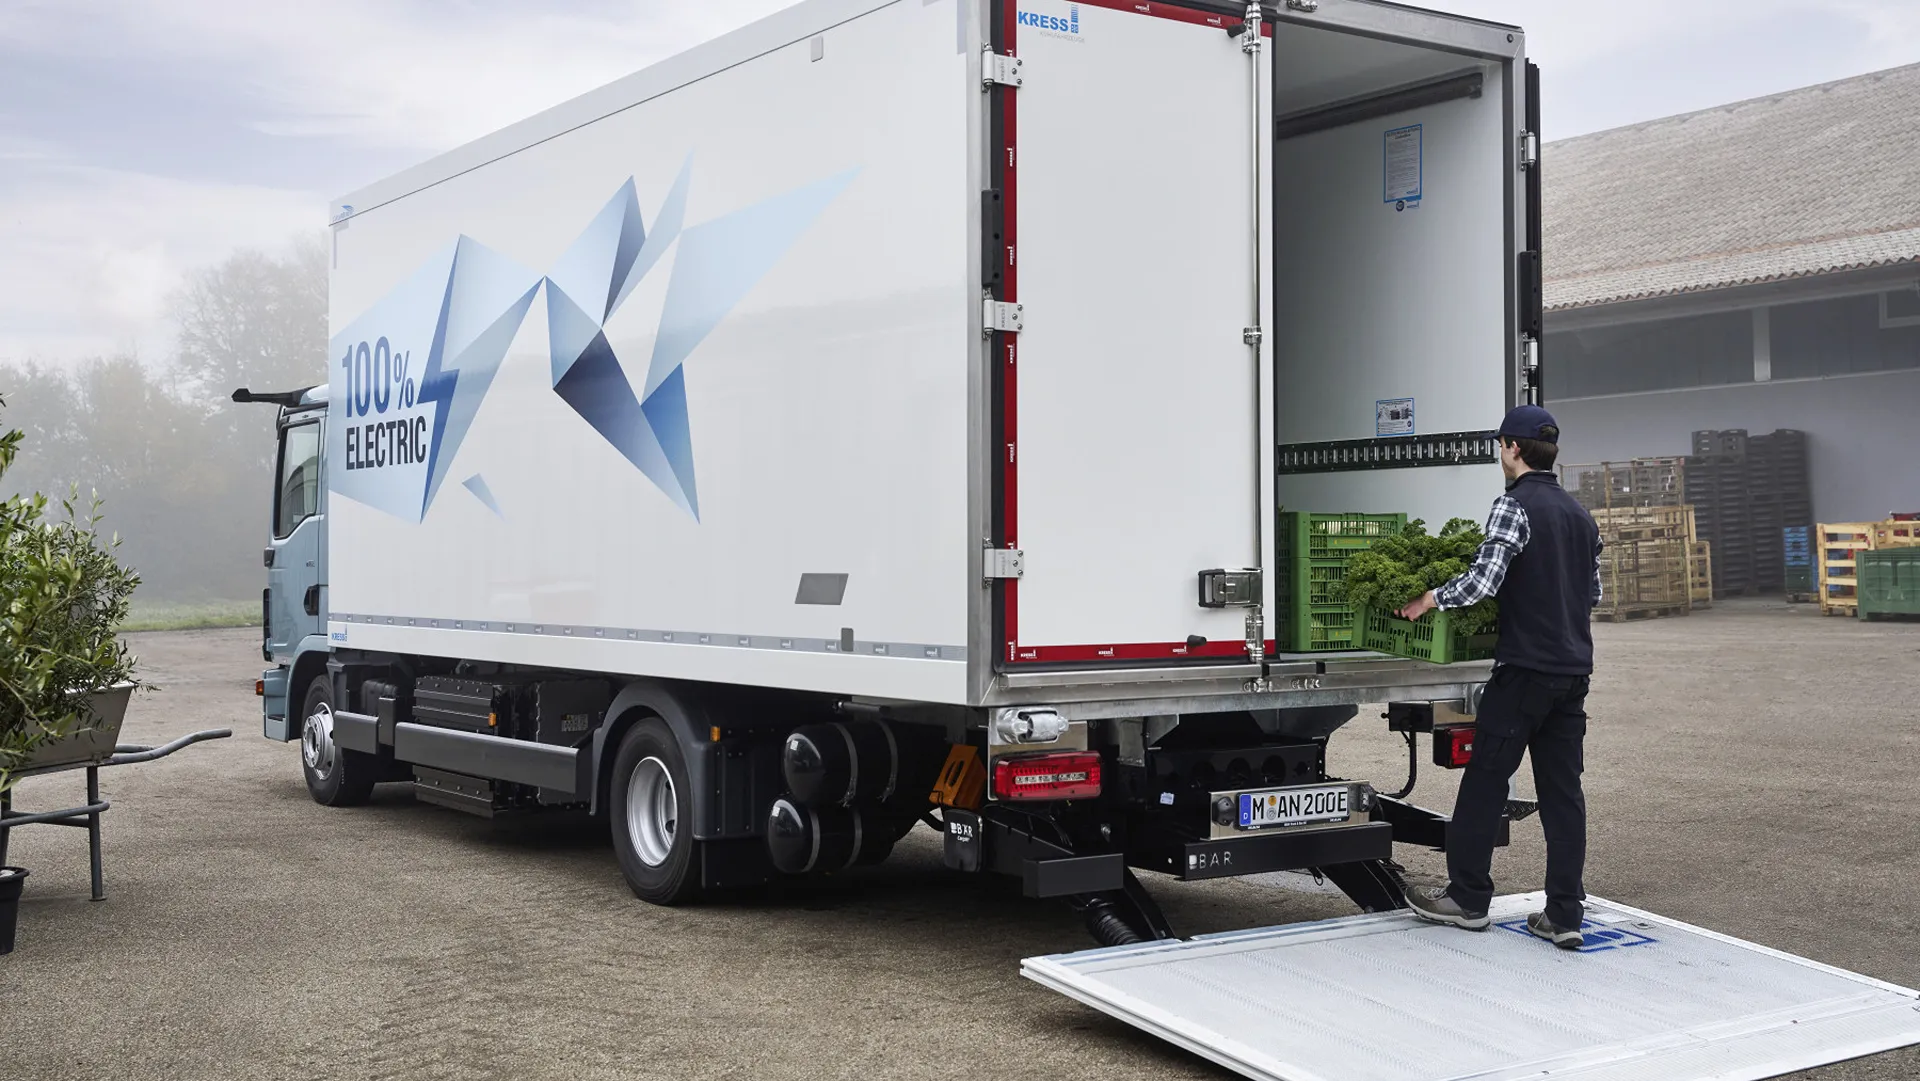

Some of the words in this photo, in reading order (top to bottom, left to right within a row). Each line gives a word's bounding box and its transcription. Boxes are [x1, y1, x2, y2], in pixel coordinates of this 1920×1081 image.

[1018, 11, 1069, 32] KRESS
[342, 336, 414, 417] 100%
[346, 415, 426, 470] ELECTRIC
[1243, 812, 1249, 820] D
[1253, 797, 1264, 820] M
[1278, 794, 1301, 818] AN
[1304, 791, 1348, 816] 200E
